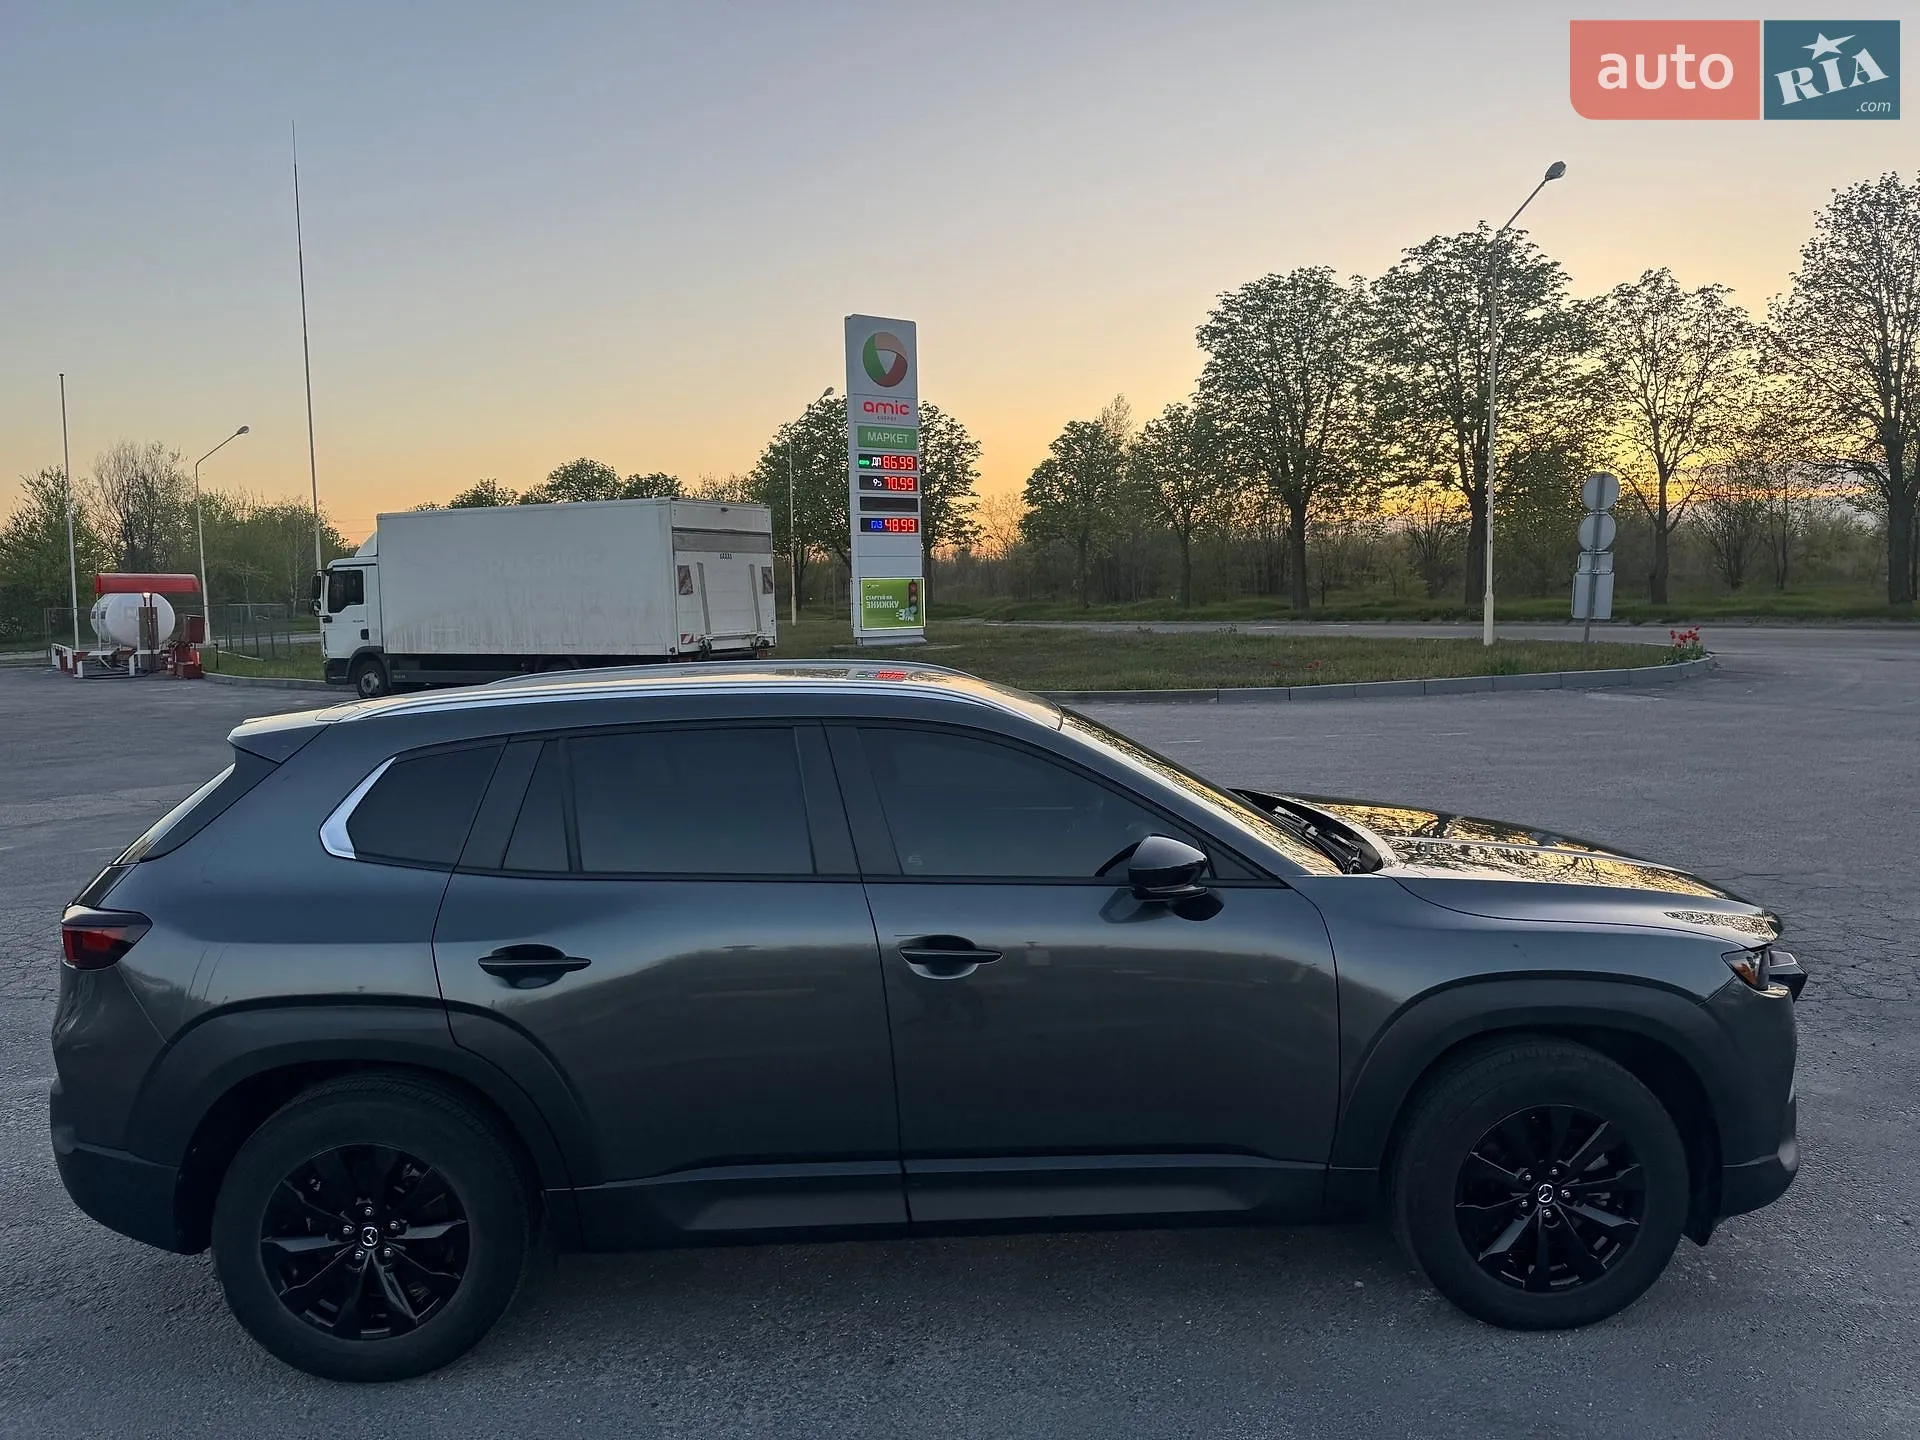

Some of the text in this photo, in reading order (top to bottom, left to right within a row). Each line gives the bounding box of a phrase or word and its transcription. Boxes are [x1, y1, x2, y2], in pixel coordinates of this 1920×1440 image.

[863, 400, 910, 416] amic
[867, 431, 910, 445] МАРКЕТ
[884, 476, 914, 491] 70.99
